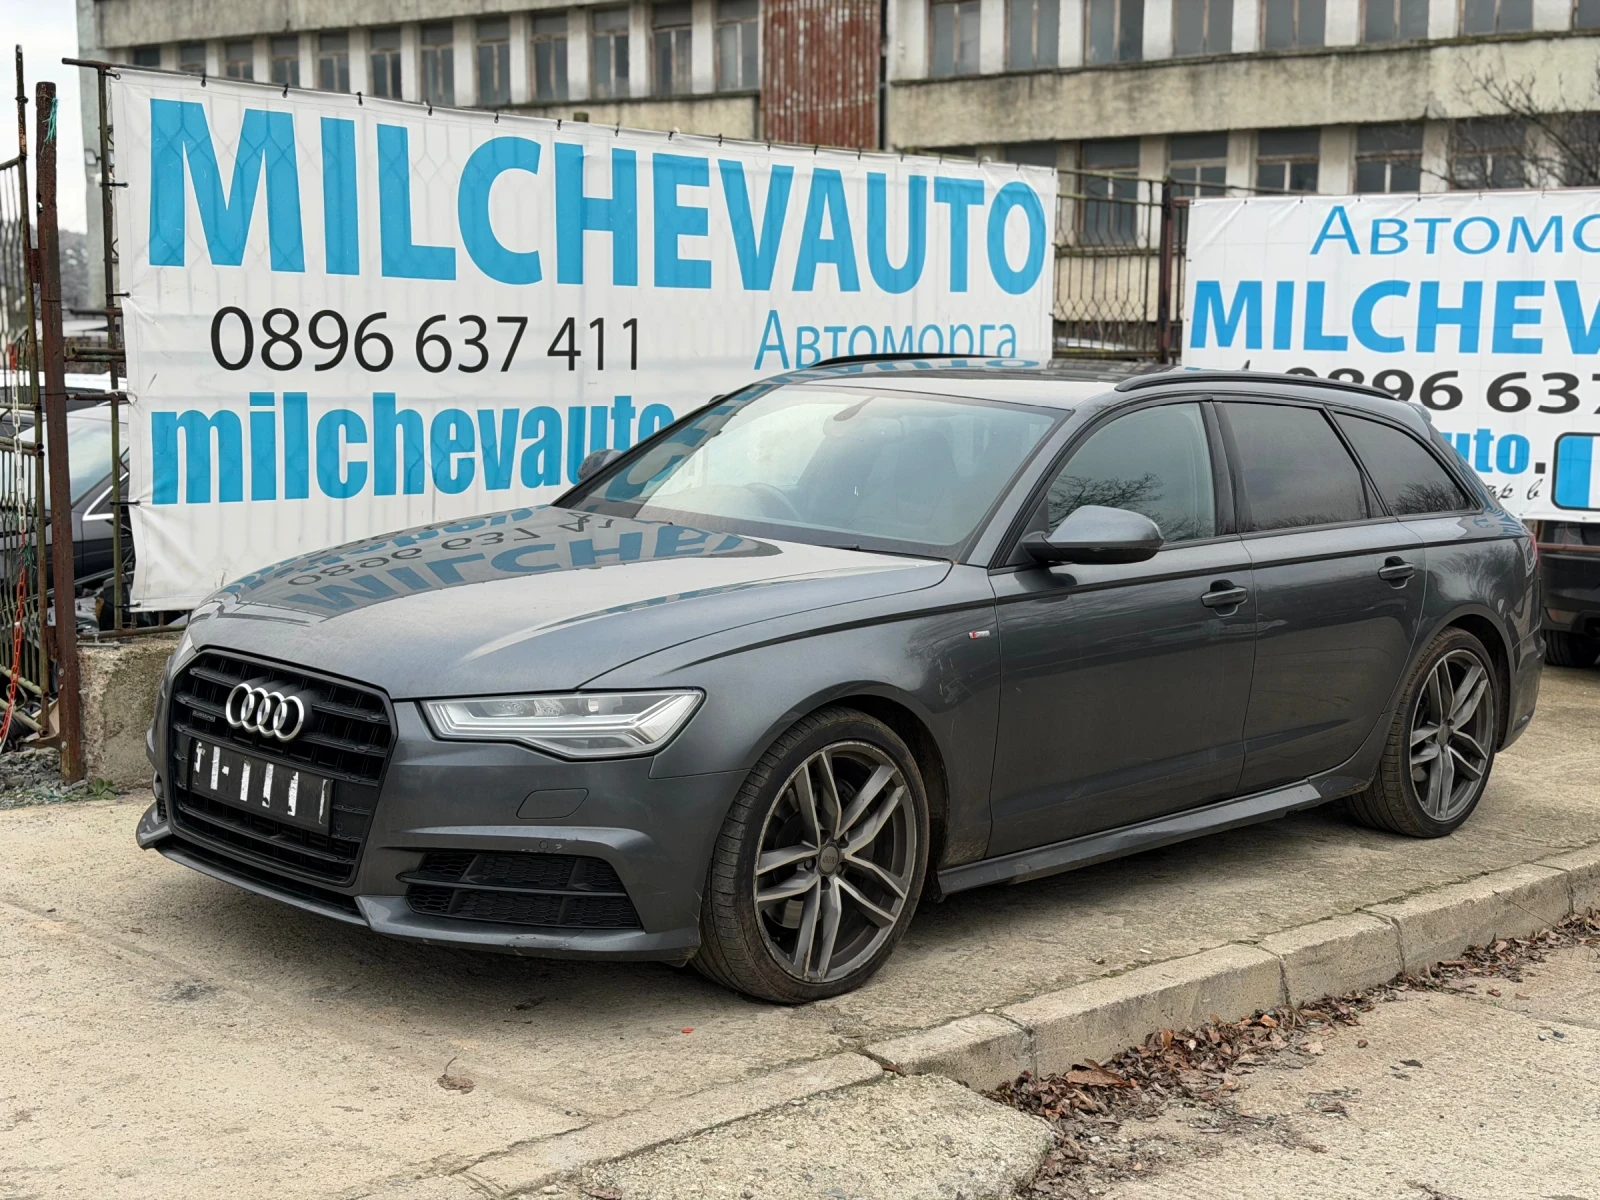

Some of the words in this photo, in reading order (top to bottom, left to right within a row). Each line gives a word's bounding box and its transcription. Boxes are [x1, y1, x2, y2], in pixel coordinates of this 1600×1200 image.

[149, 98, 1046, 295] MILCHEVAUTO
[210, 306, 394, 373] 0896
[415, 314, 530, 373] 637
[547, 317, 639, 371] 411
[1190, 280, 1600, 354] MILCHEV
[1284, 367, 1463, 411] 96
[1486, 371, 1600, 415] 63
